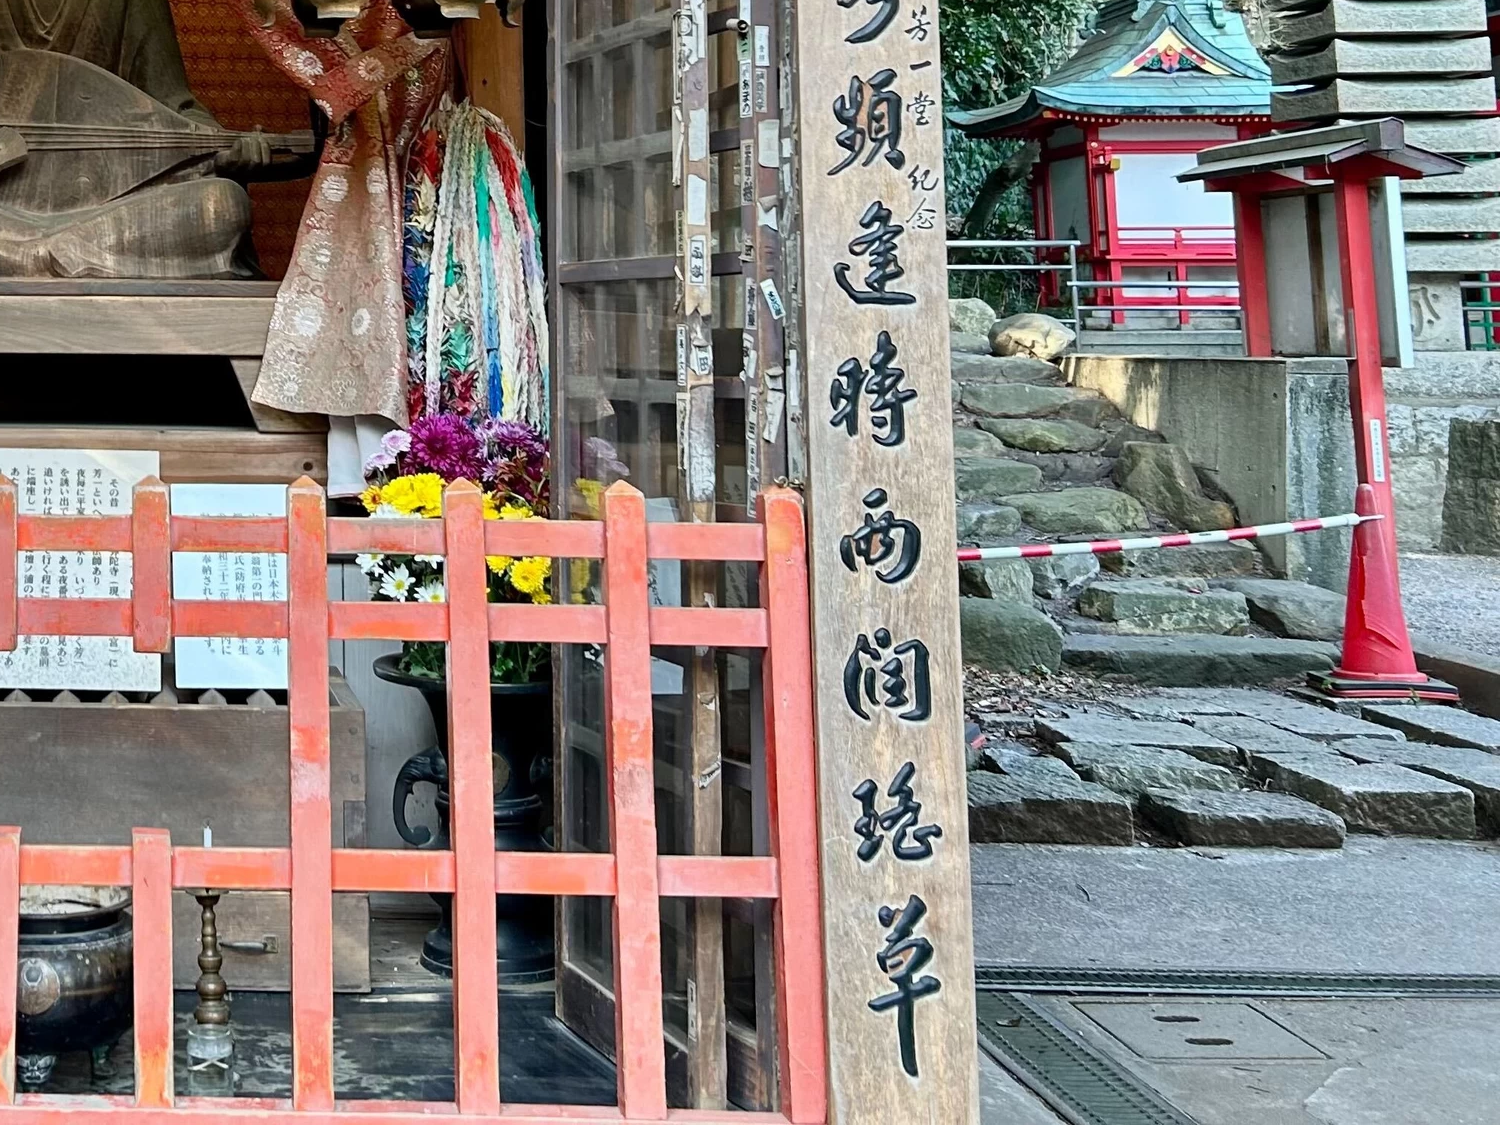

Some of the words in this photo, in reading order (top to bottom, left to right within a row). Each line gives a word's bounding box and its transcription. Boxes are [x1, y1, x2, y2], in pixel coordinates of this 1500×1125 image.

[904, 7, 936, 127] 芳一堂
[109, 478, 120, 508] その昔
